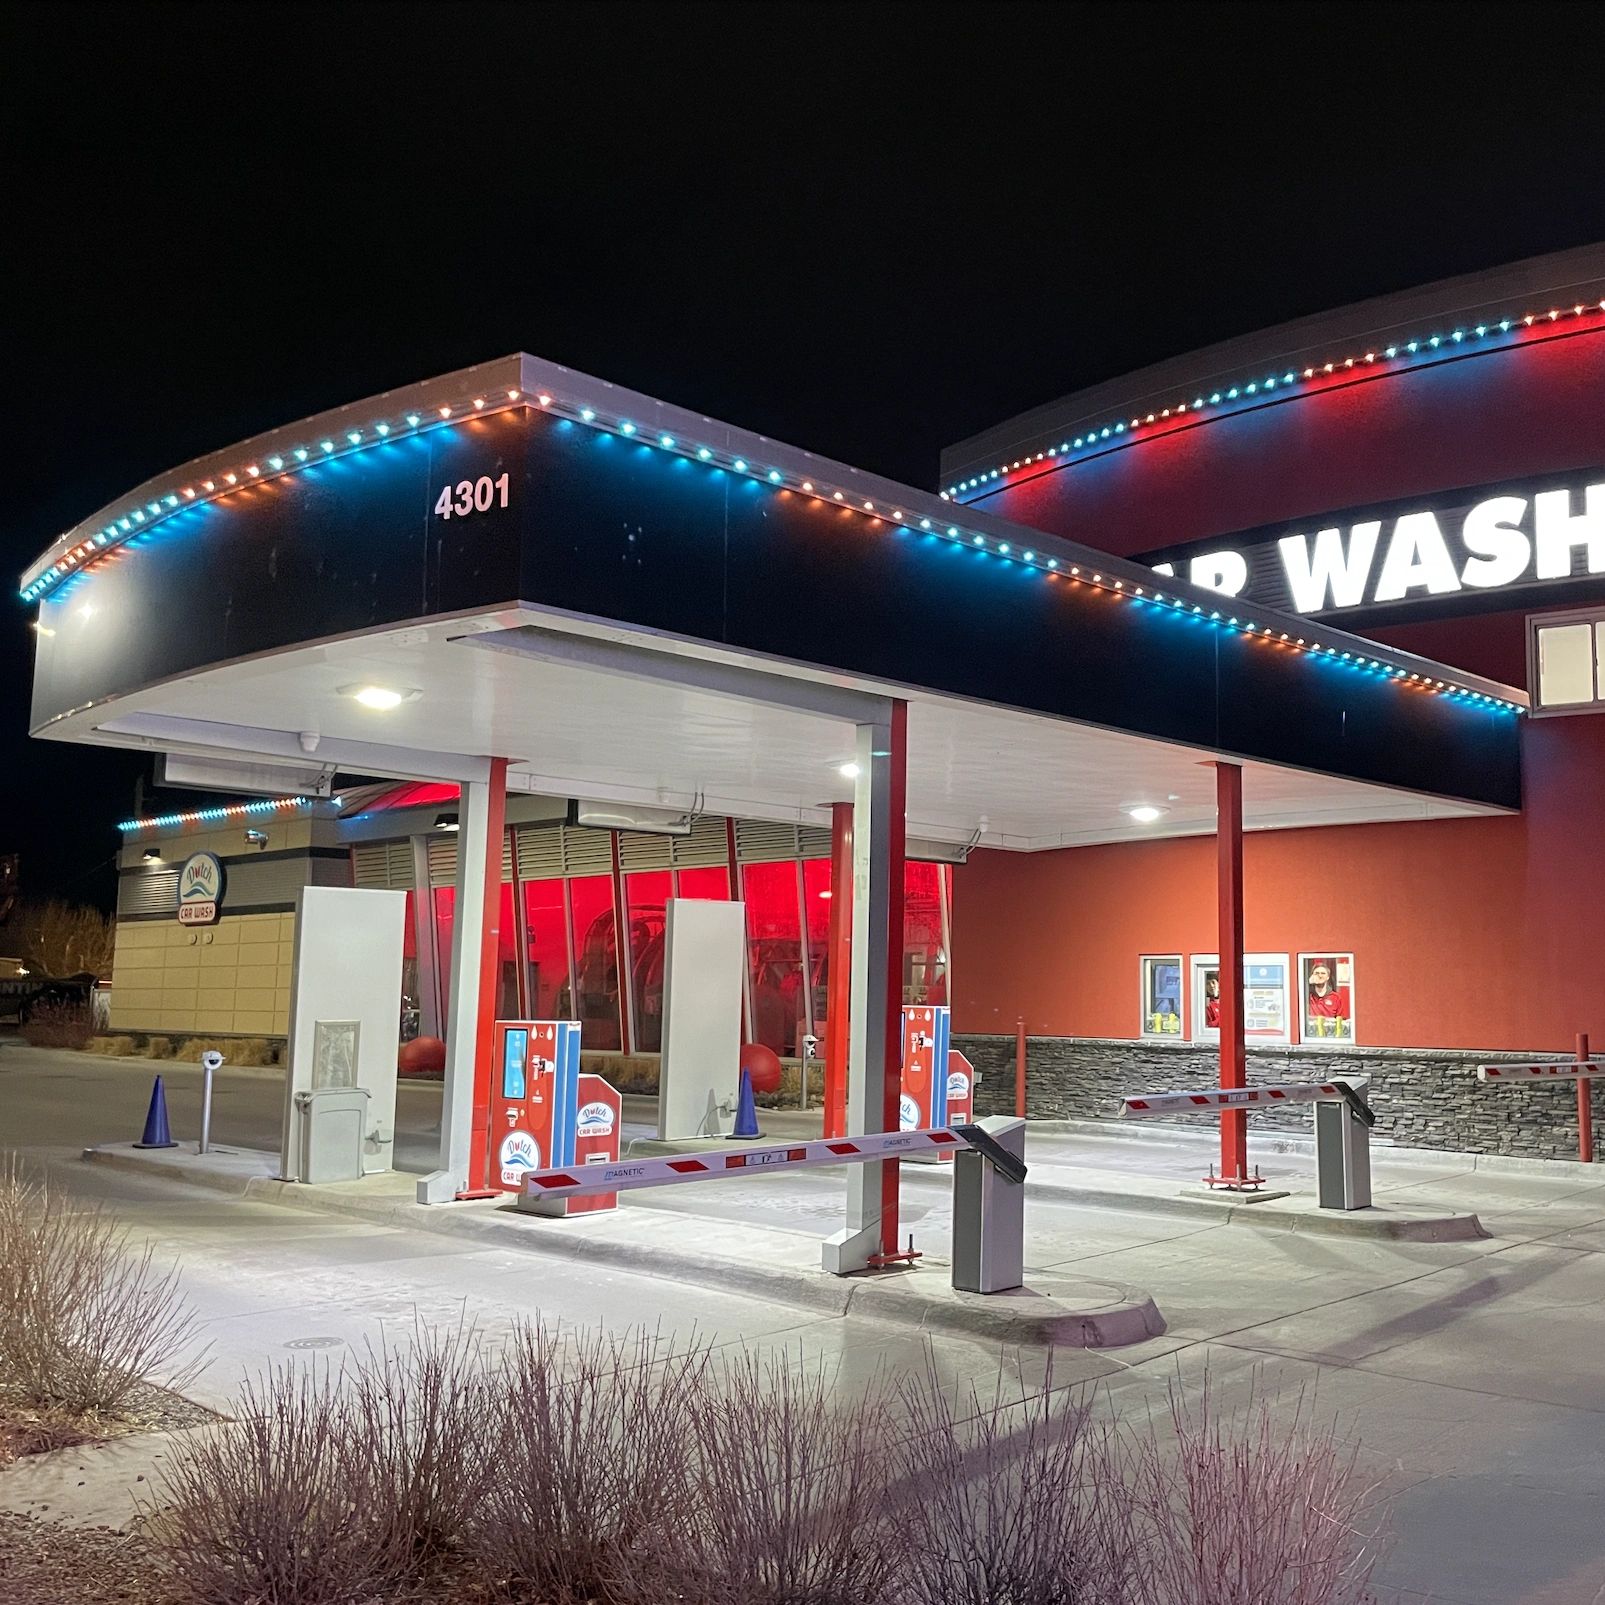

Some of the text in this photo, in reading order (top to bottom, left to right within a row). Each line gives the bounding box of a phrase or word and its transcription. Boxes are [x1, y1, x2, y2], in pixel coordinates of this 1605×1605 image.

[434, 472, 509, 520] 4301
[1278, 483, 1605, 614] WASH
[186, 862, 212, 884] Dutch
[181, 906, 214, 919] CAR WASH
[582, 1107, 607, 1118] Dutch
[508, 1139, 532, 1157] Dutch
[503, 1171, 515, 1181] CAR
